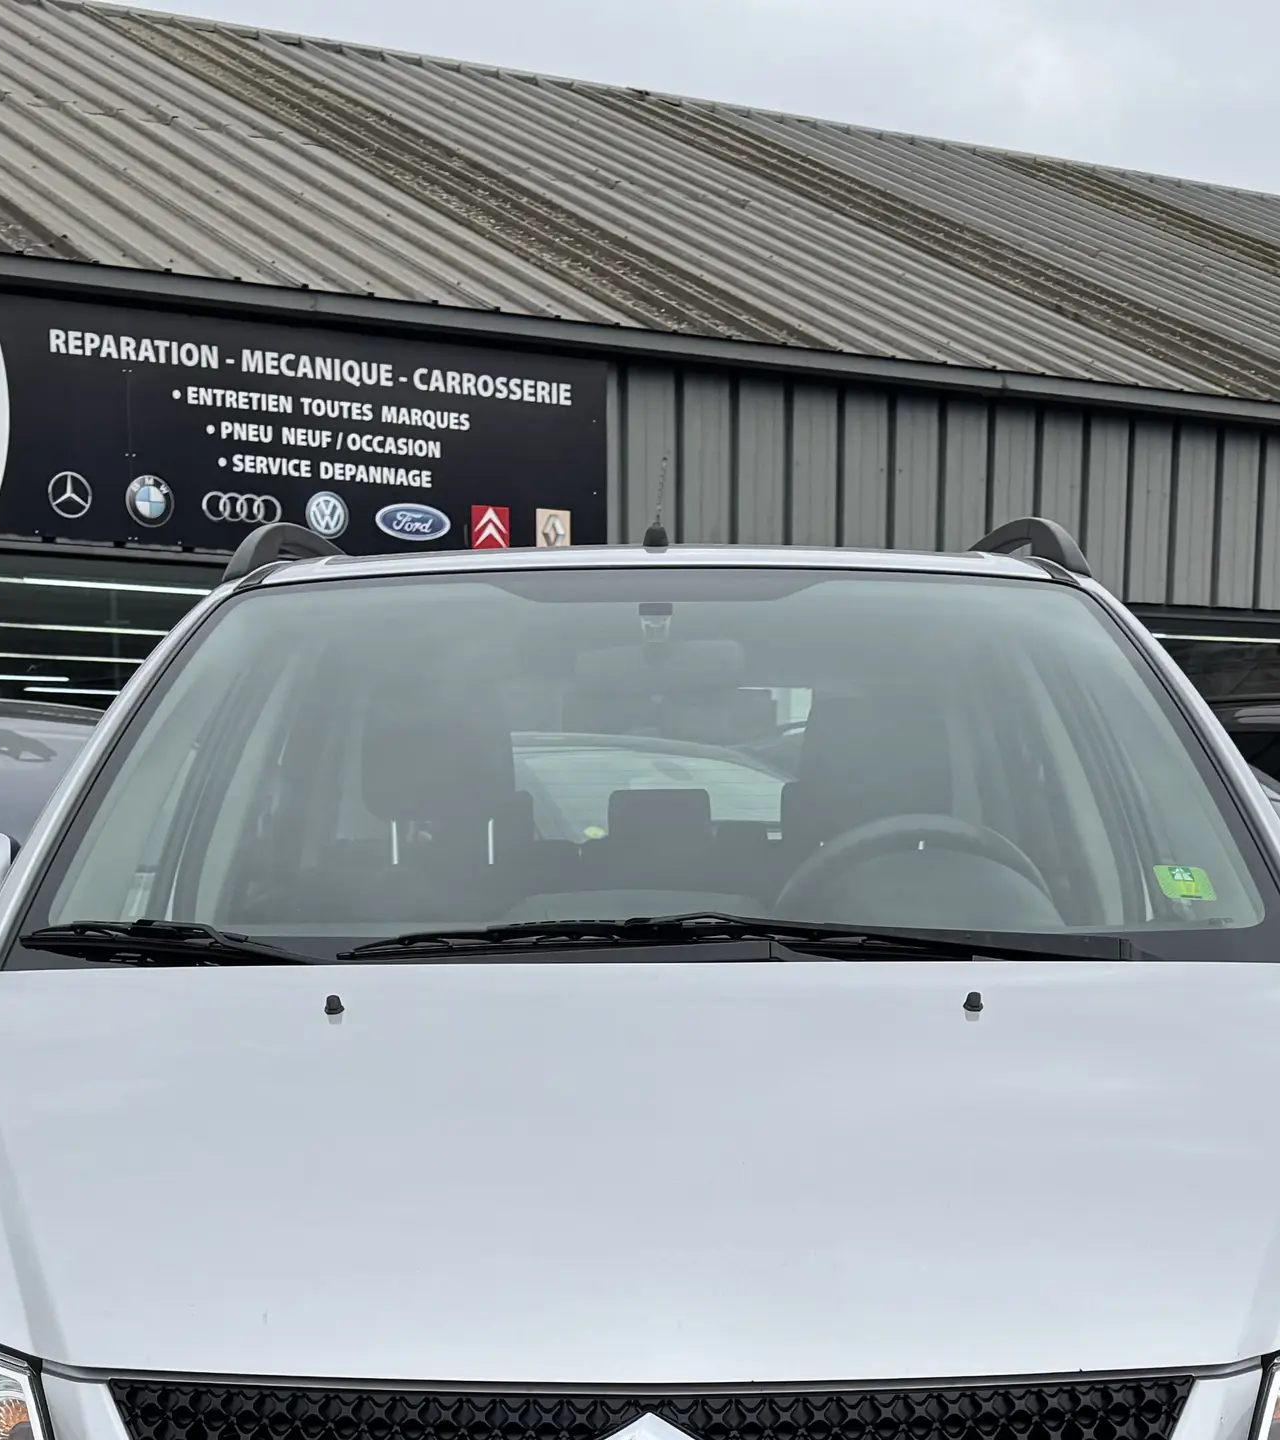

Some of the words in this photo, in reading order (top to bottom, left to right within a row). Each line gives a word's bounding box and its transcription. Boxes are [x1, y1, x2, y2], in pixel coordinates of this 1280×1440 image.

[49, 328, 219, 369] REPARATION
[241, 349, 394, 387] MECANIQUE
[413, 367, 573, 406] CARROSSERIE
[186, 386, 293, 414] ENTRETIEN
[300, 397, 374, 421] TOUTES
[381, 405, 470, 431] MARQUES
[220, 421, 273, 443] PNEU
[232, 454, 312, 478] SERVICE
[320, 461, 433, 488] DEPANNAGE
[392, 510, 433, 534] Ford
